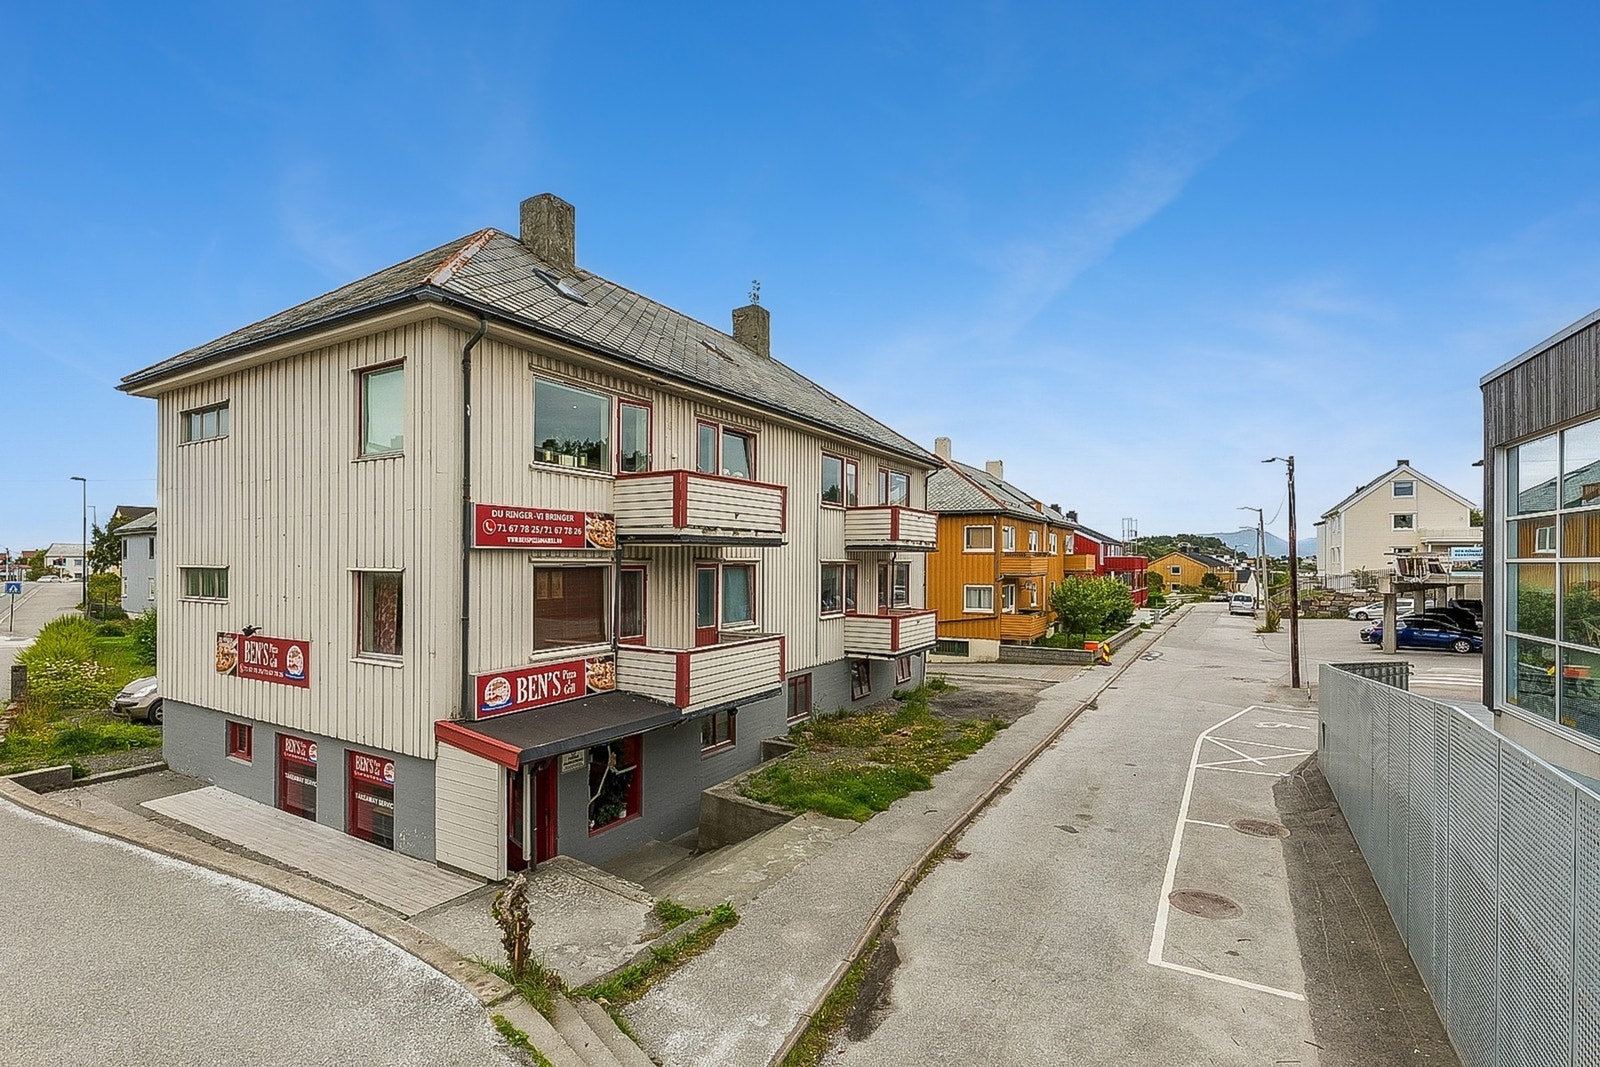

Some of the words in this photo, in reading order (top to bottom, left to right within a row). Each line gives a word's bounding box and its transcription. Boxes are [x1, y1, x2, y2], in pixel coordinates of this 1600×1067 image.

[491, 509, 504, 518] DU
[545, 512, 575, 522] BRINGER
[497, 523, 507, 532] 71
[508, 524, 518, 533] 67
[520, 525, 530, 533] 78
[554, 526, 563, 534] 67
[564, 526, 573, 535] 78
[574, 527, 582, 535] 26
[244, 640, 269, 666] BEN'S
[516, 670, 561, 704] BEN'S
